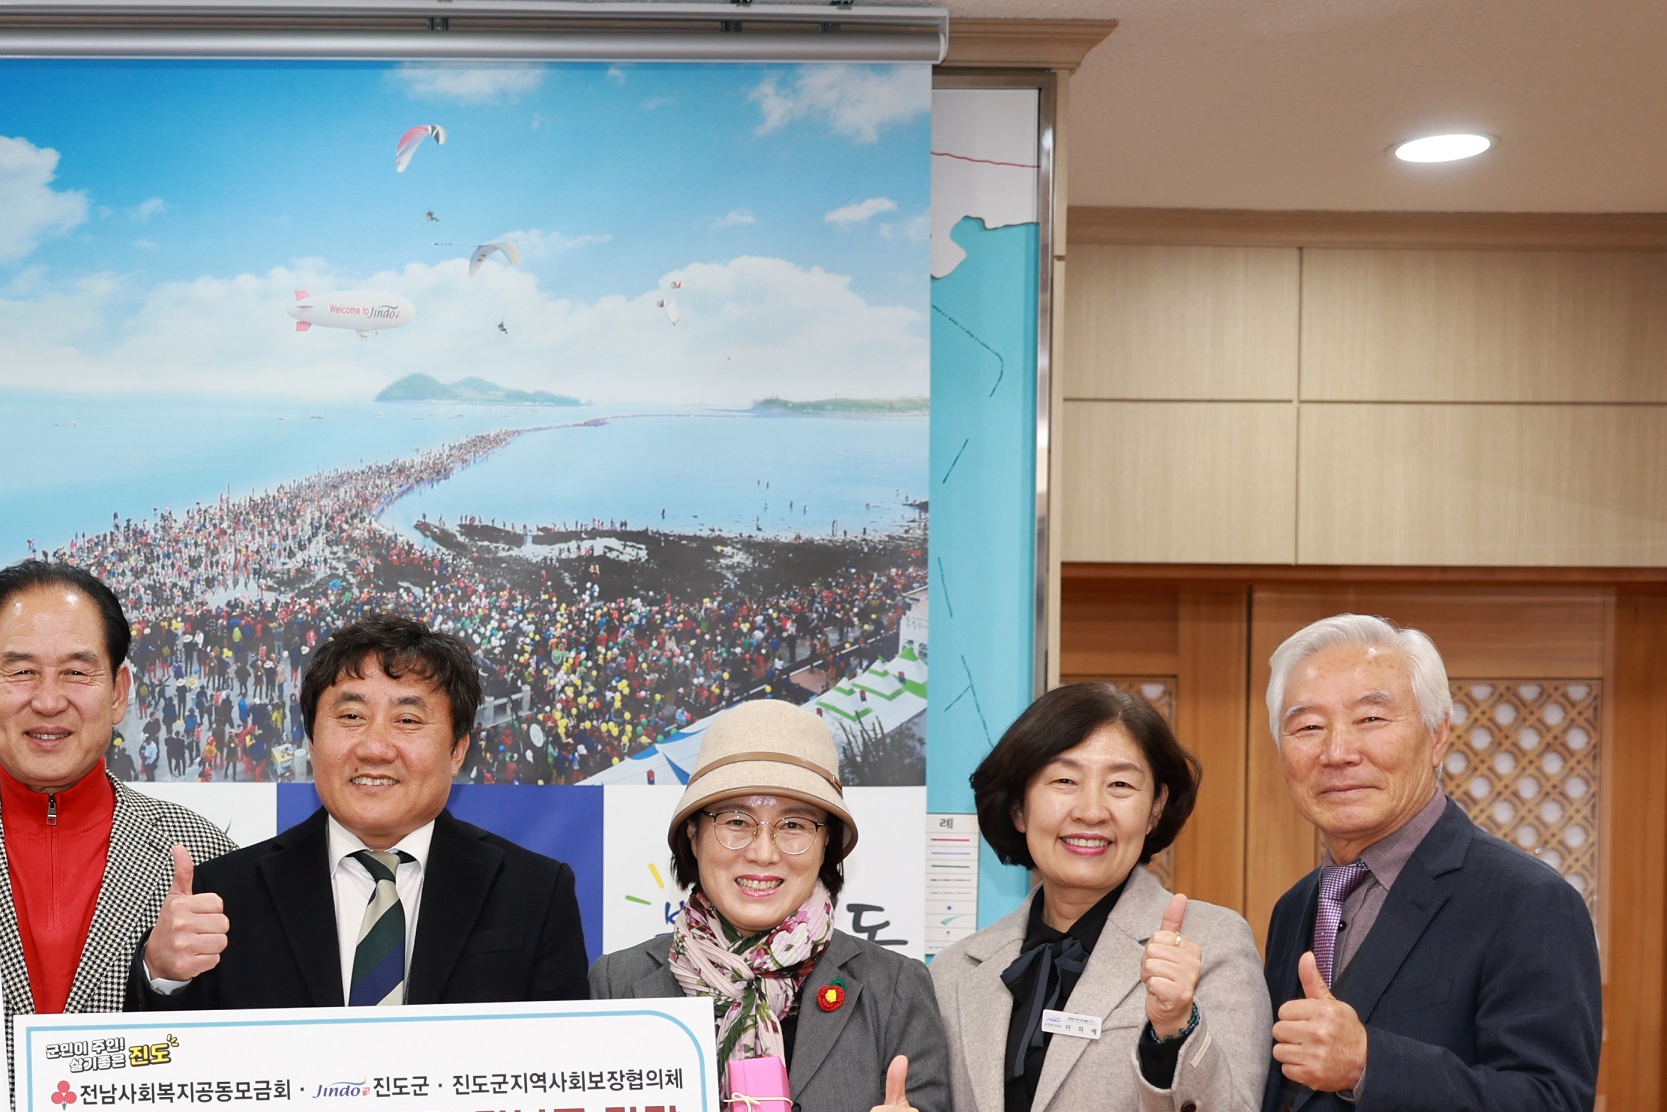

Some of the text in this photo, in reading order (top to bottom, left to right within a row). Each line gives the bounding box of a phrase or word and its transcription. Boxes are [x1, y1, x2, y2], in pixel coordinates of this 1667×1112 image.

[330, 304, 397, 319] Welcome to Jindo
[45, 1036, 126, 1060] 군민이 주인!
[69, 1042, 172, 1073] 살기좋은 진도
[79, 1067, 683, 1105] 전남사회복지공동모금회 Jindo 진도군 진도군지역사회보장협의체
